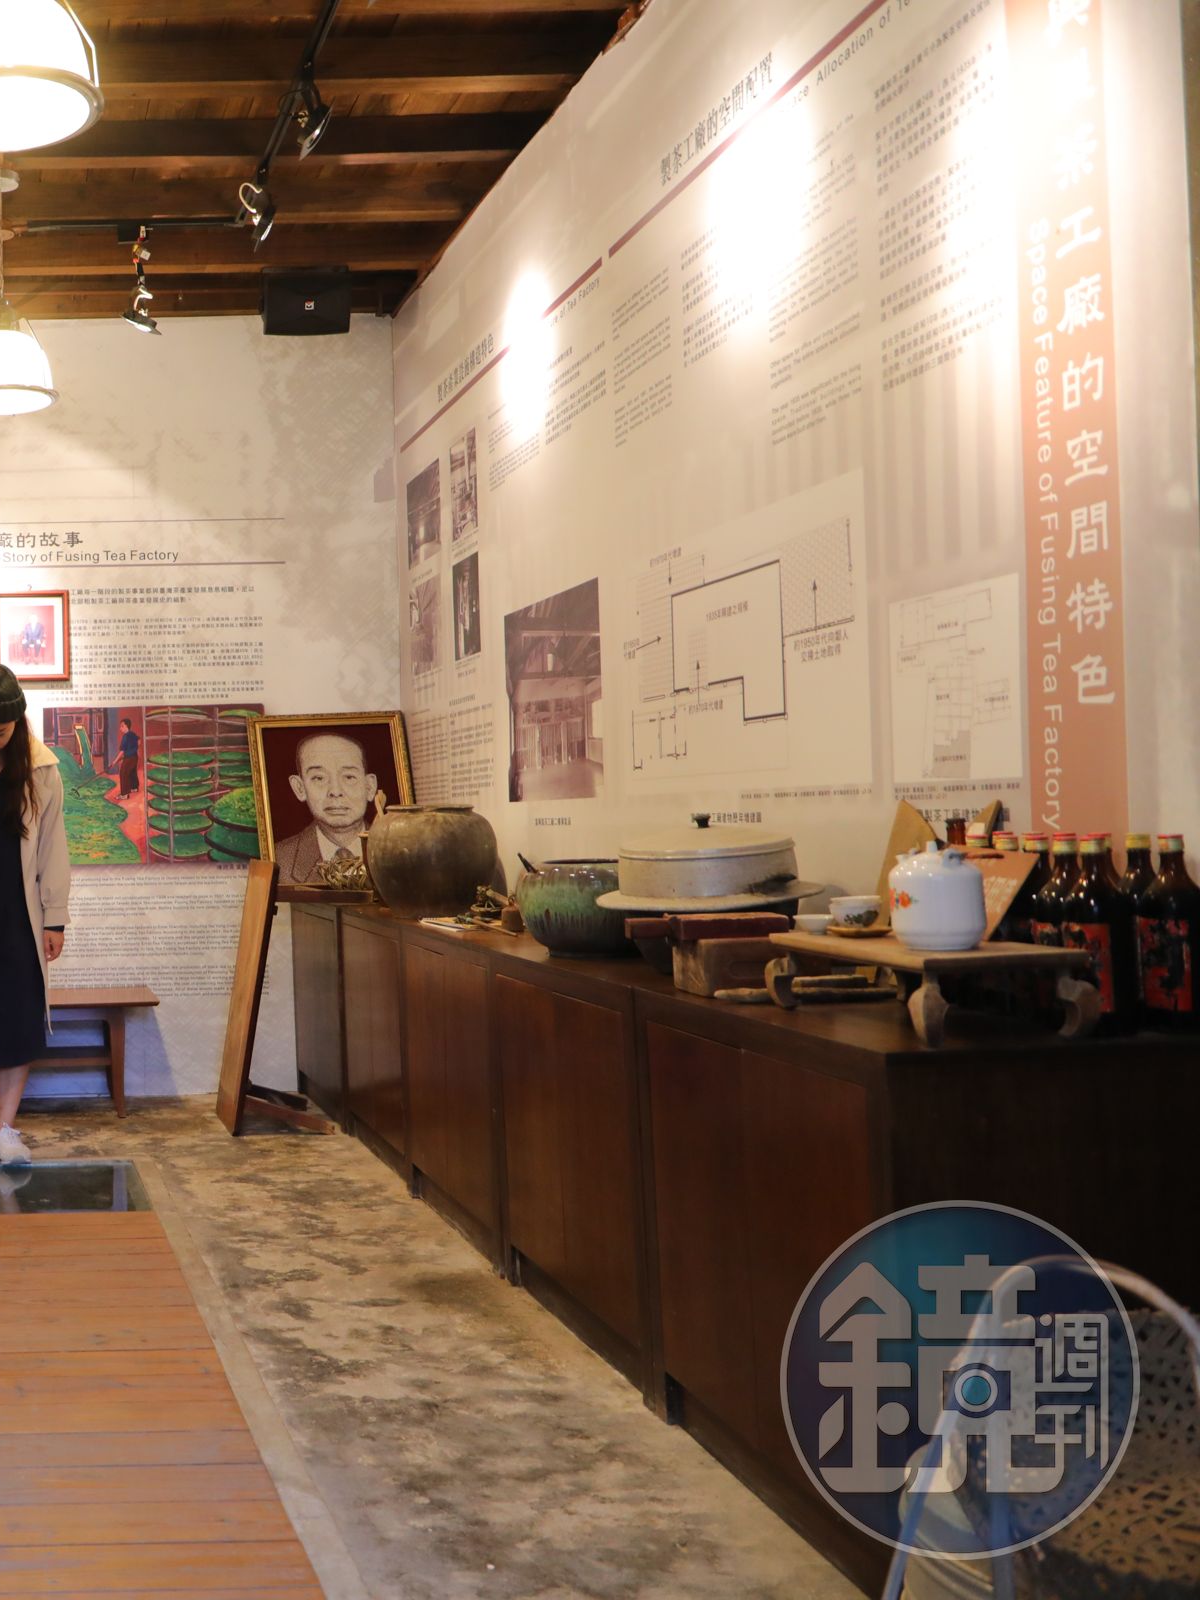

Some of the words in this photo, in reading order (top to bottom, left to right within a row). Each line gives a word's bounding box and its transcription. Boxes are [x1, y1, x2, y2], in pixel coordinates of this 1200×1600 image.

[815, 27, 874, 87] Allocation
[879, 5, 891, 29] of
[660, 50, 773, 187] 製茶工廠的空間配置
[1026, 217, 1050, 326] Space
[1033, 330, 1054, 463] Feature
[1038, 471, 1058, 503] of
[40, 551, 52, 562] of
[56, 551, 100, 564] Fusing
[103, 550, 127, 562] Tea
[130, 550, 180, 563] Factory
[1038, 511, 1060, 626] Fusing
[1042, 633, 1062, 694] Tea
[1042, 704, 1063, 831] Factory
